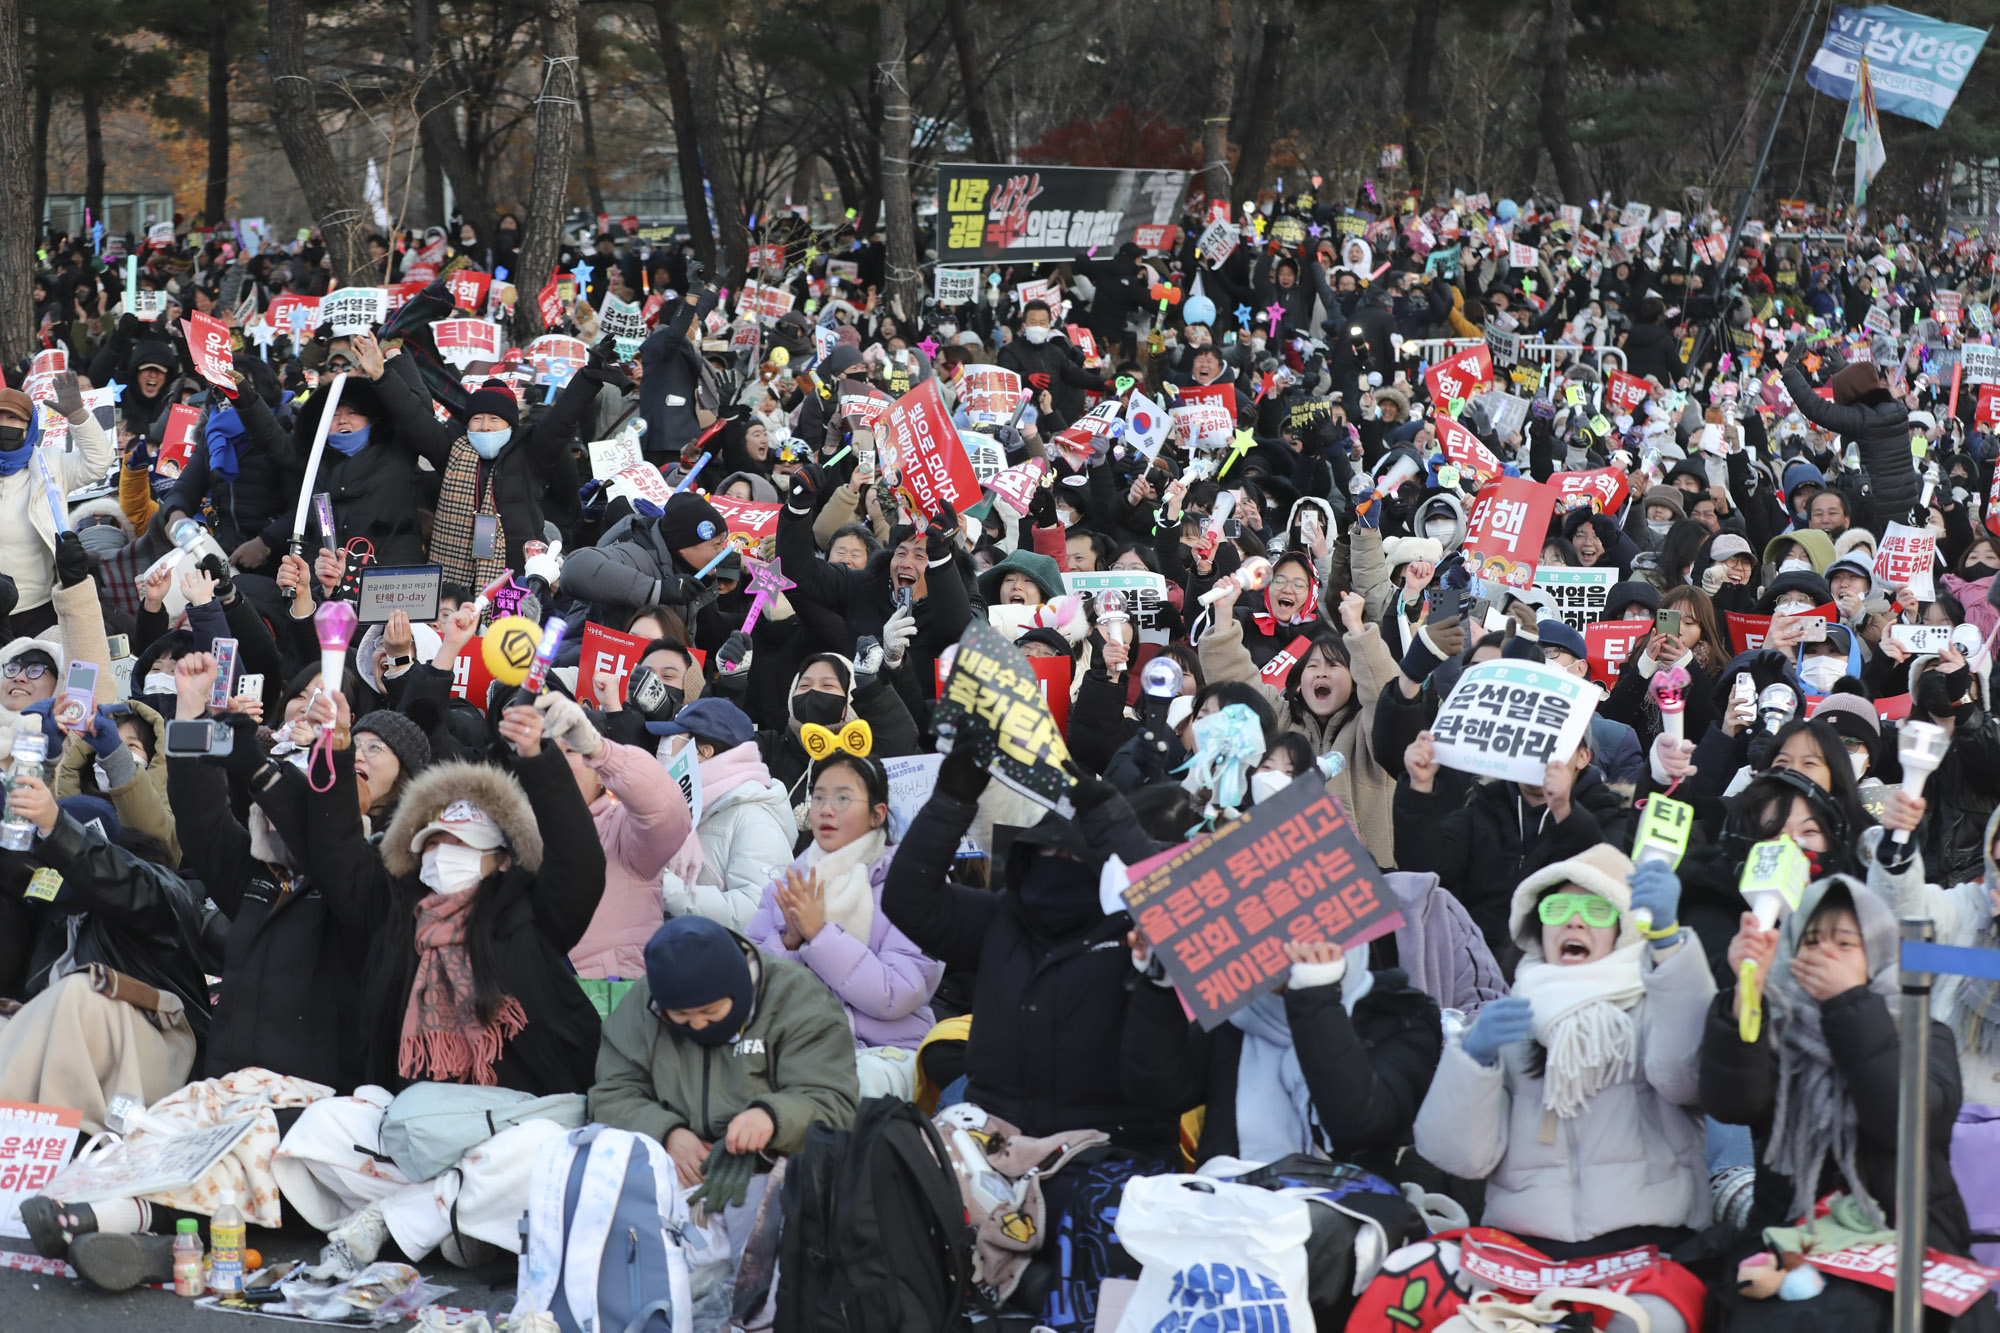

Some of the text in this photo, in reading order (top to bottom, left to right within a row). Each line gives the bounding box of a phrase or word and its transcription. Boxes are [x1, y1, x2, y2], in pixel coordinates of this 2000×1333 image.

[947, 178, 990, 212] 내란
[948, 214, 986, 248] 공범
[323, 298, 379, 315] 윤석열을
[1611, 381, 1647, 406] 탄핵
[896, 422, 922, 476] 때까지
[907, 401, 937, 457] 빛으로
[925, 455, 960, 504] 모이자
[1446, 429, 1499, 473] 탄핵
[1562, 472, 1620, 508] 탄핵
[1466, 496, 1528, 553] 탄핵
[1873, 551, 1933, 583] 체포하라
[375, 592, 427, 604] 탄핵 D-day
[958, 648, 1037, 702] 내란수괴
[1448, 682, 1572, 731] 윤석열을
[1432, 716, 1558, 764] 탄핵하라
[1651, 799, 1688, 844] 탄
[1138, 796, 1346, 946] 올콘병 못버리고
[1173, 847, 1356, 974] 집회 올출하는
[1195, 877, 1381, 1011] 케이팝 응원단
[733, 1039, 766, 1057] FIFA
[0, 1137, 68, 1161] 윤석열
[0, 1163, 59, 1193] 하라
